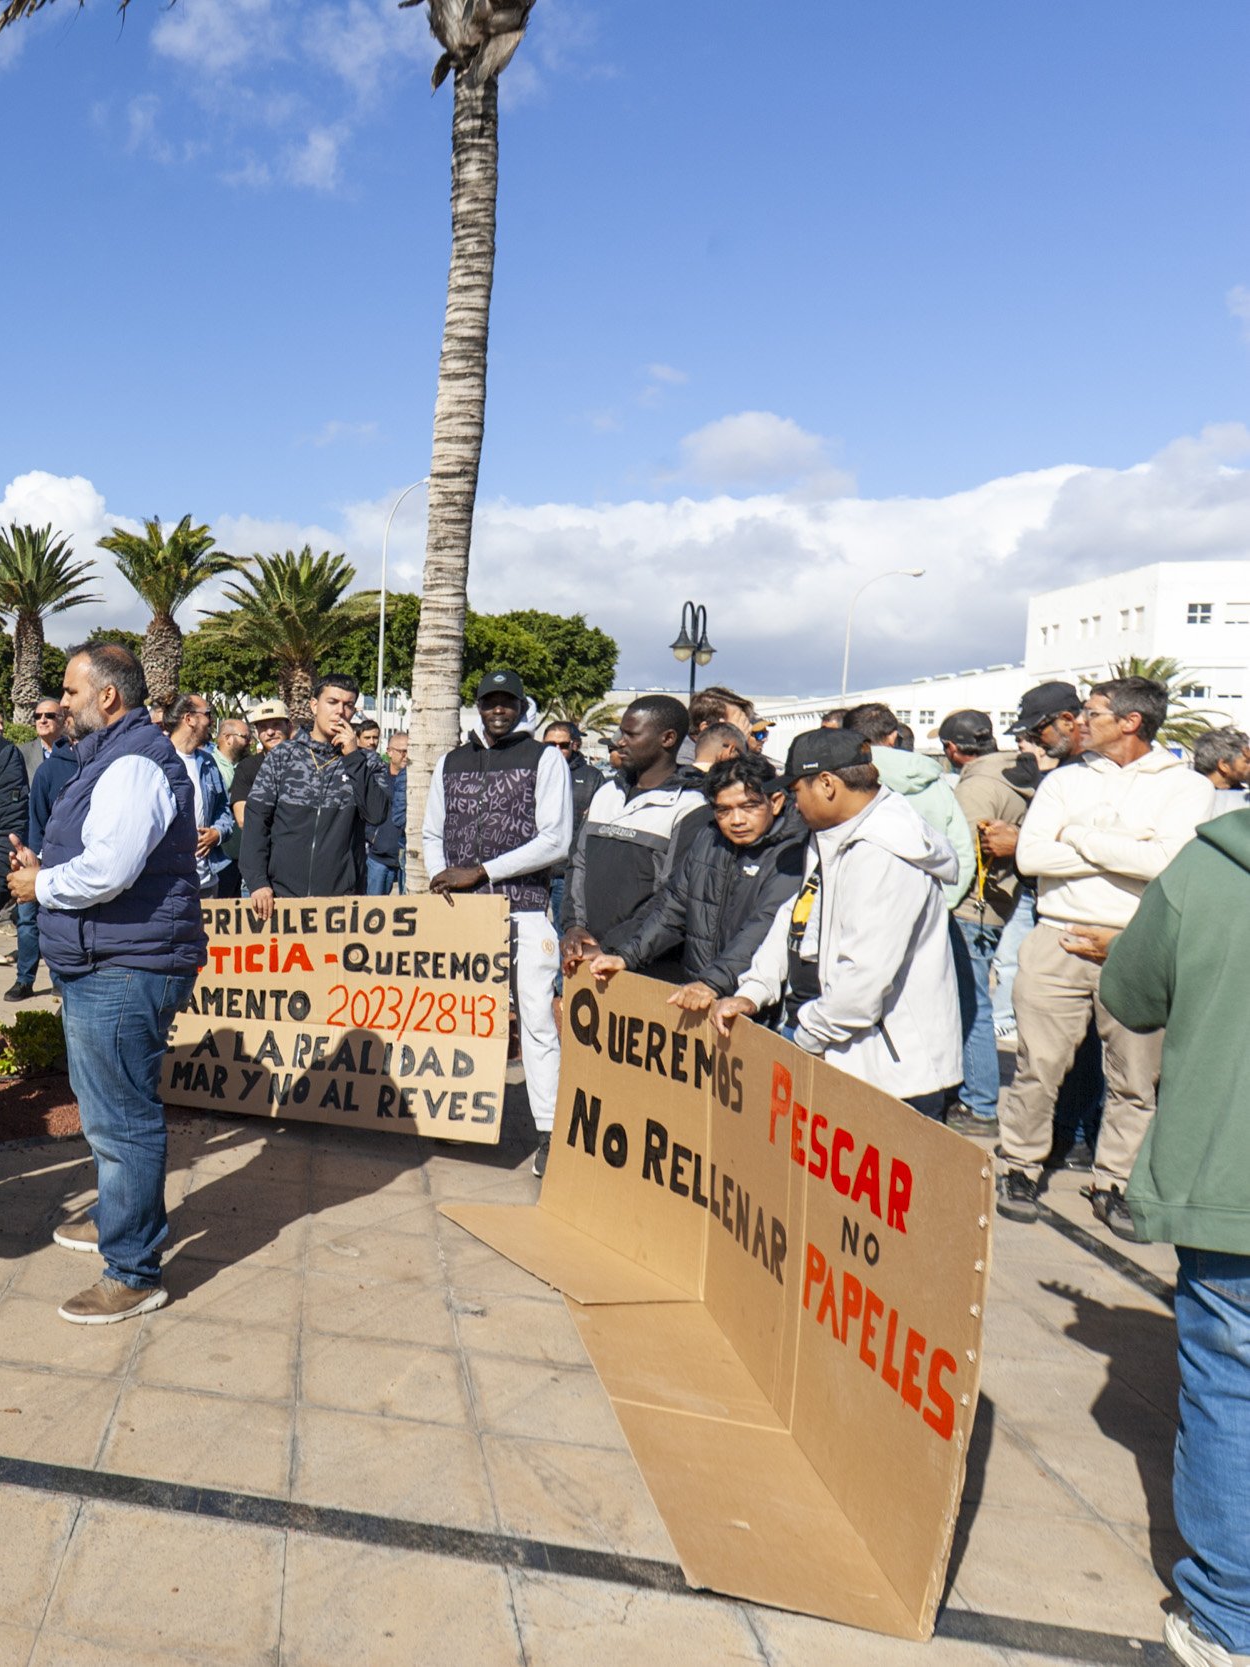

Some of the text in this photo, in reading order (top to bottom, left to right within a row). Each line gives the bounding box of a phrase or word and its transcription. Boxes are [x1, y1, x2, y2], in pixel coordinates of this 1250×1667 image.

[197, 937, 314, 975] TICIA
[342, 942, 511, 985] QUEREMOS
[178, 984, 497, 1042] AMENTO 2023/2843
[190, 1028, 221, 1058] A
[233, 1029, 286, 1068] LA
[291, 1032, 475, 1078] REALIDAD
[170, 1060, 498, 1125] MAR Y NO AL REVES
[570, 987, 913, 1235] QUEREMOS PESCAR
[641, 1117, 788, 1286] RELLENAR
[840, 1215, 881, 1267] NO
[803, 1242, 958, 1442] PAPELES
